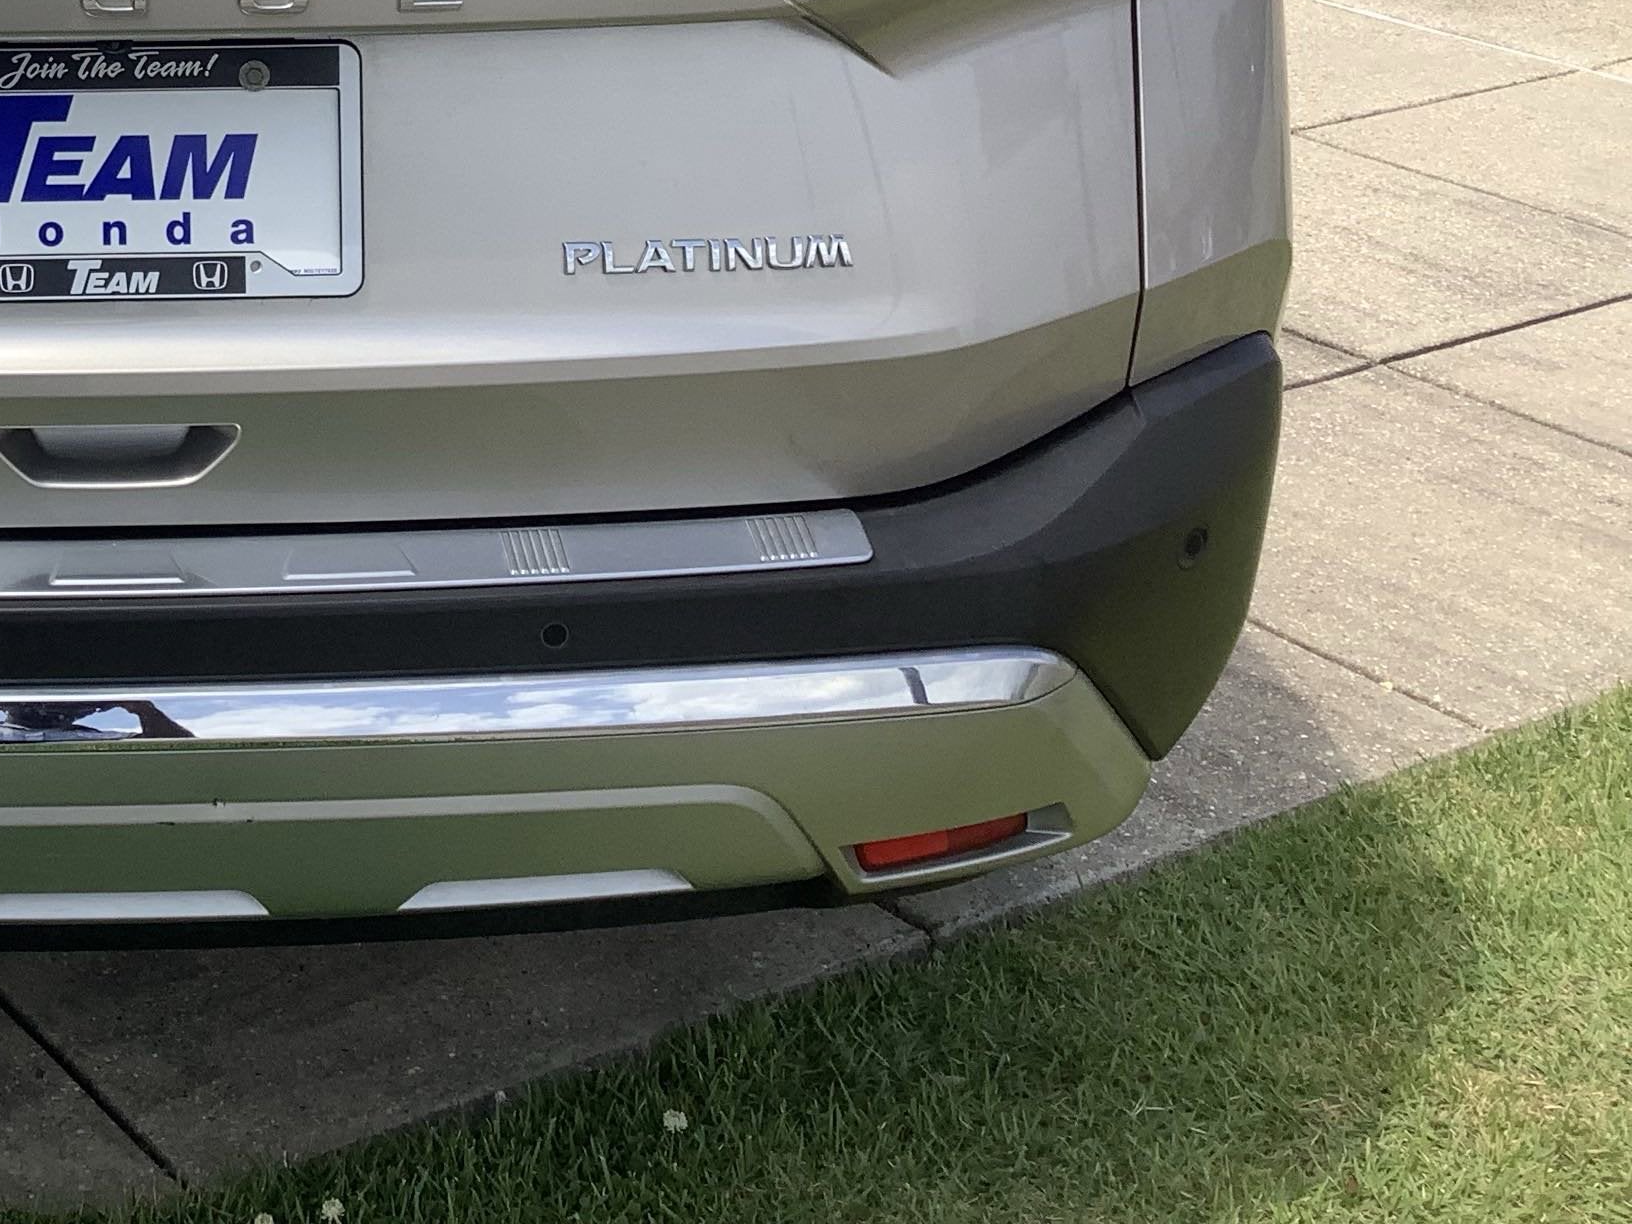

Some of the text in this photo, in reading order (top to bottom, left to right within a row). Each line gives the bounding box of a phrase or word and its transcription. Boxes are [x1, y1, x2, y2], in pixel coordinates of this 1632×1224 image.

[71, 51, 126, 81] The
[127, 51, 220, 80] Team!
[562, 233, 854, 276] PLATINUM
[66, 259, 161, 295] TEAM
